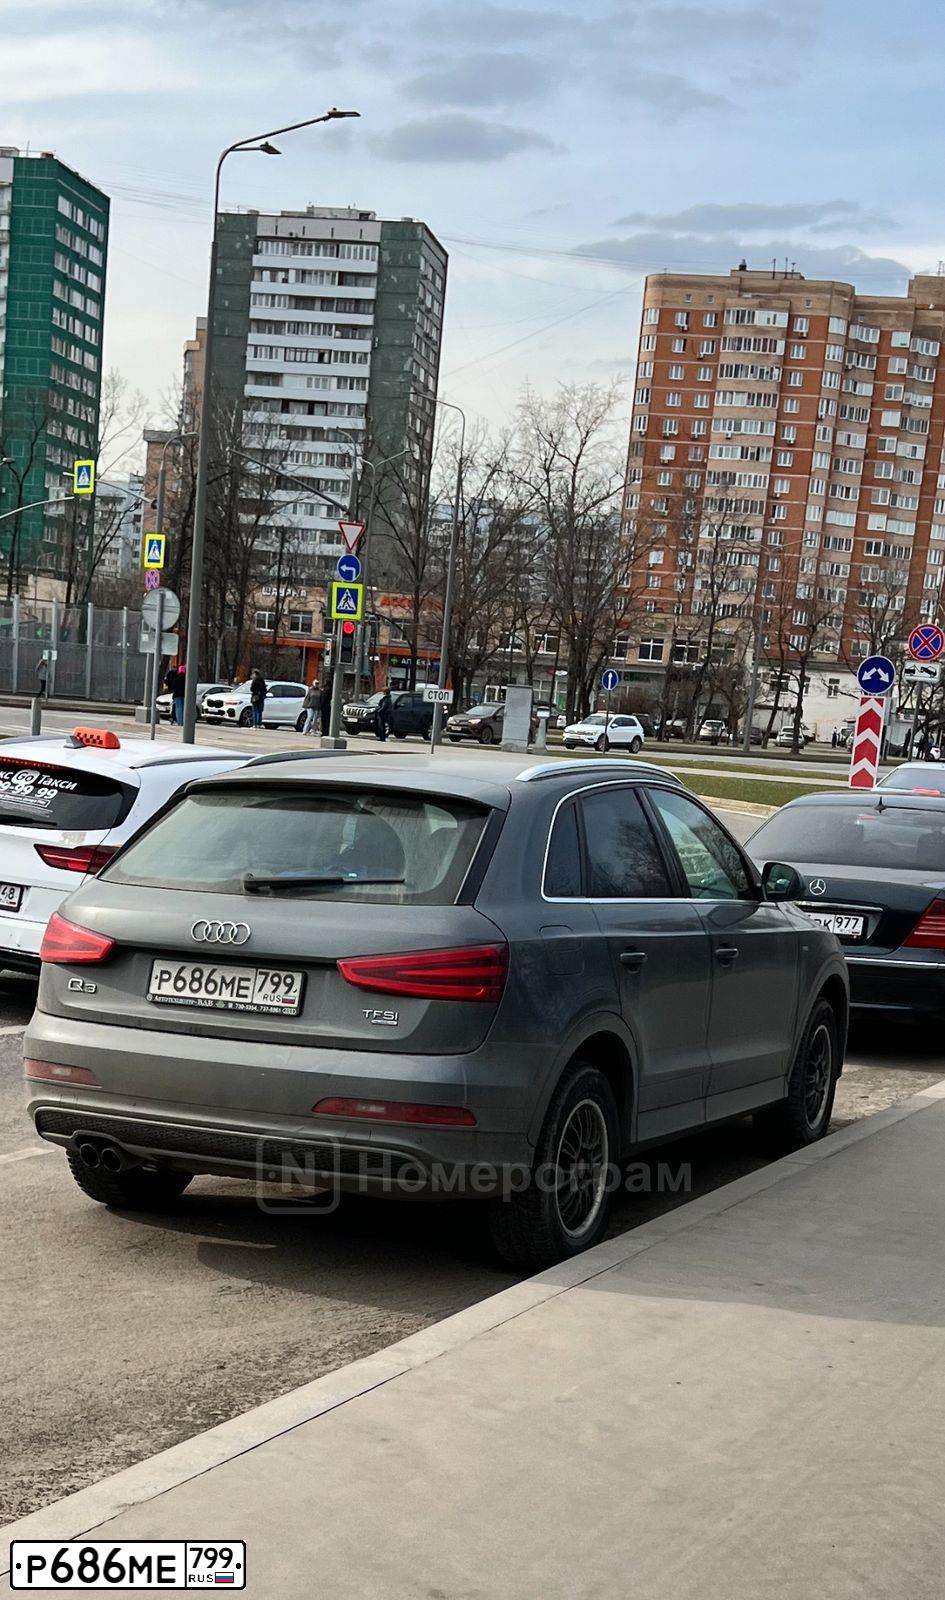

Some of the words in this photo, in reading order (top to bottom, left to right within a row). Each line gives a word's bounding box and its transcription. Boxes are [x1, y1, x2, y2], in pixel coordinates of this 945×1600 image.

[401, 658, 431, 667] АПЕКА
[428, 690, 449, 701] СТОП
[0, 780, 34, 796] 9-99
[38, 774, 77, 791] Такси
[836, 916, 860, 930] 977
[68, 977, 96, 993] Q3
[157, 965, 251, 999] Р686МЕ
[258, 970, 295, 995] 799
[263, 993, 282, 1003] RUS
[362, 1009, 398, 1021] TFSI
